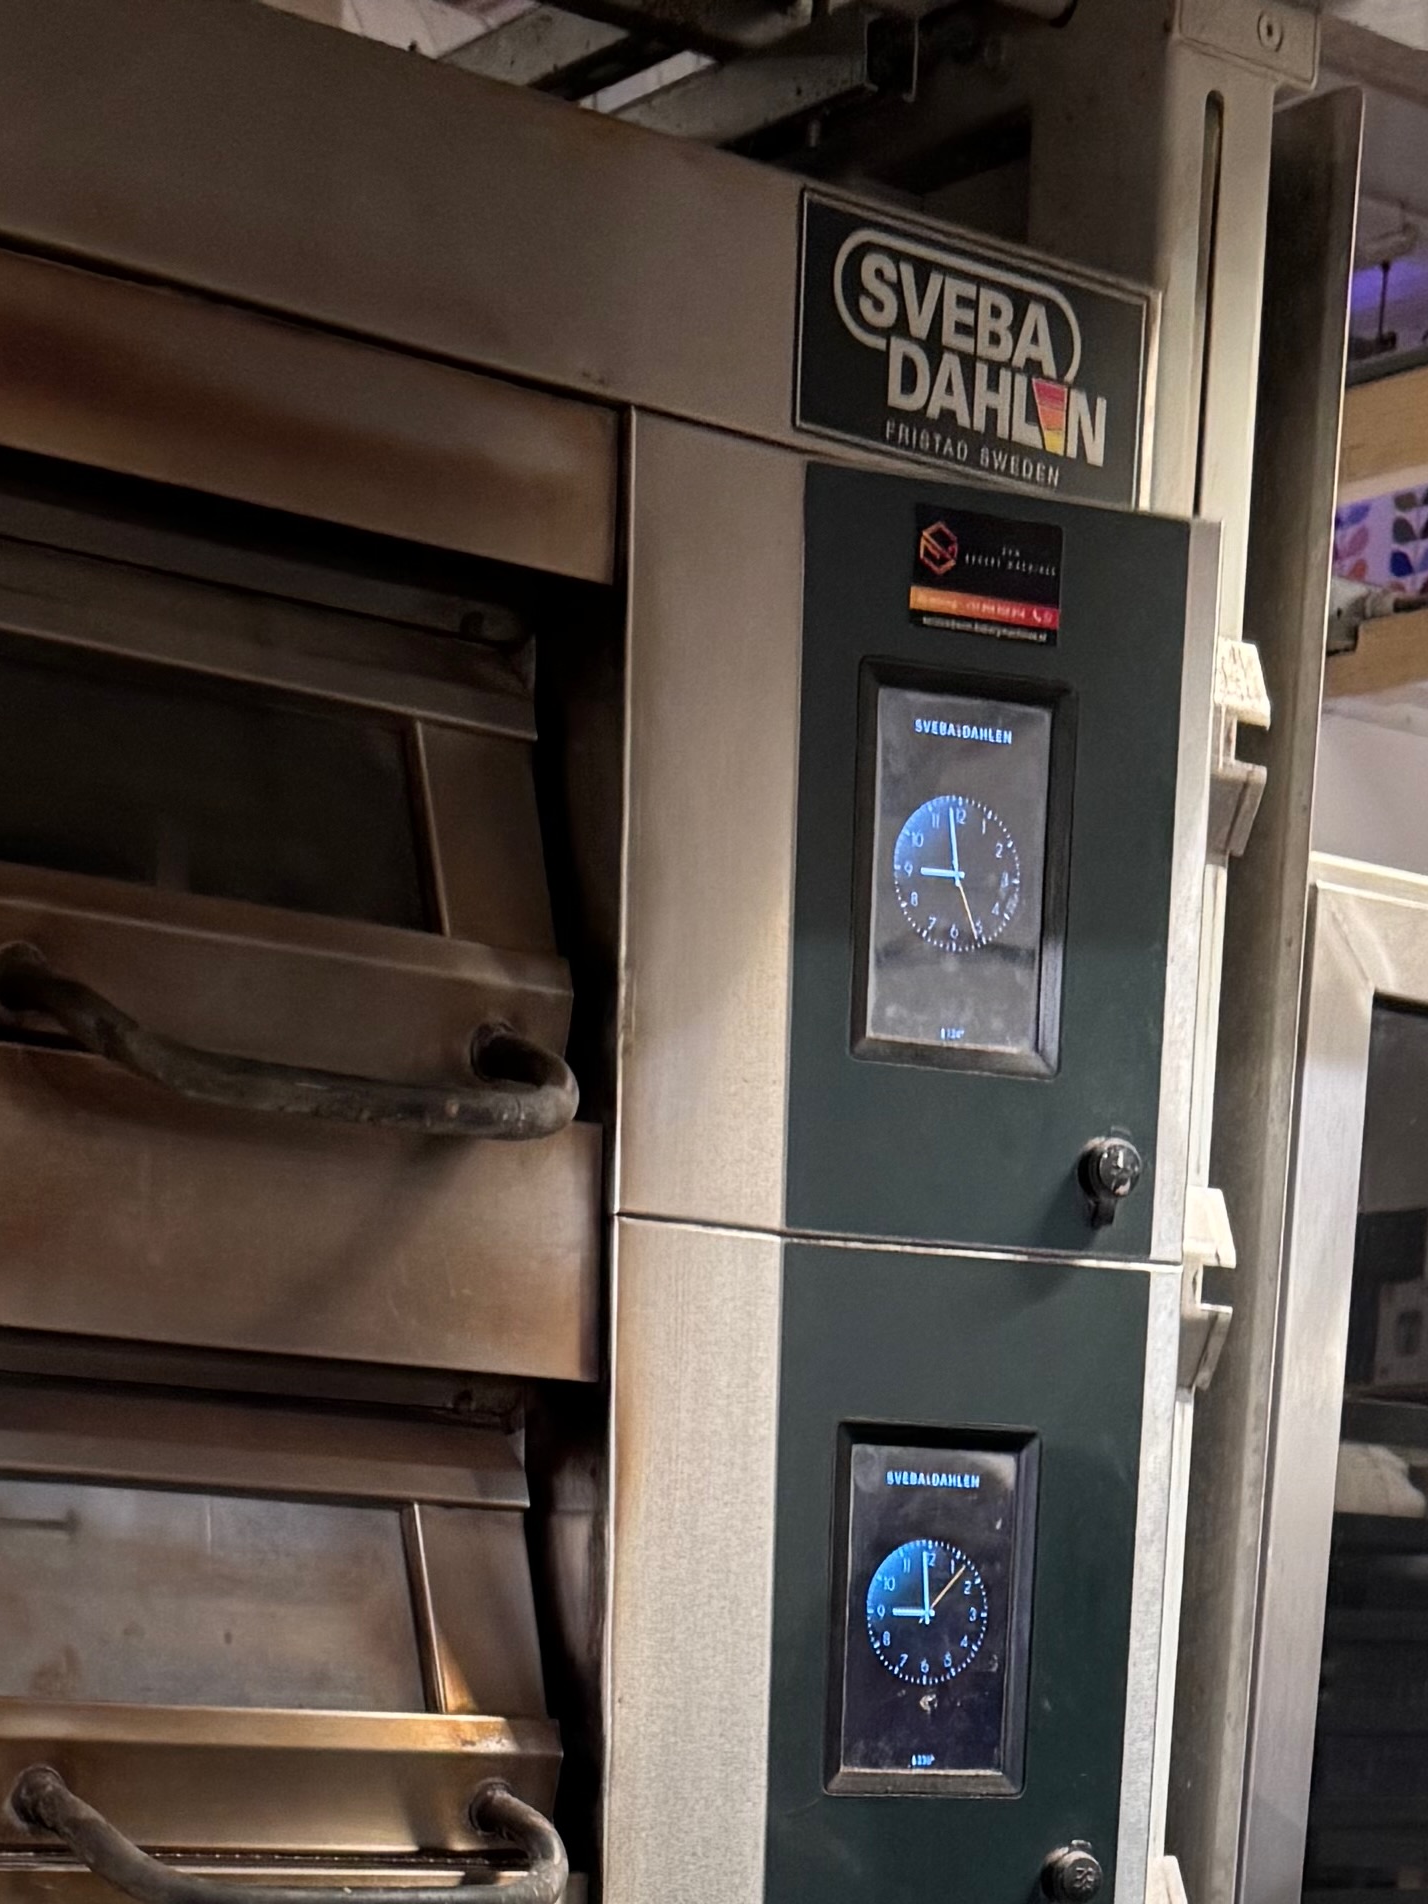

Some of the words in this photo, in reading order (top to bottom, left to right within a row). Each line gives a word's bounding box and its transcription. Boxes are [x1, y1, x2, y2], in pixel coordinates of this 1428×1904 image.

[858, 251, 1057, 380] SVEBA
[980, 445, 1060, 487] SWEDEN
[995, 842, 1003, 859] 2
[950, 923, 959, 939] 6
[964, 1580, 972, 1595] 2
[969, 1607, 977, 1622] 3
[899, 1653, 909, 1668] 7
[920, 1658, 929, 1674] 6
